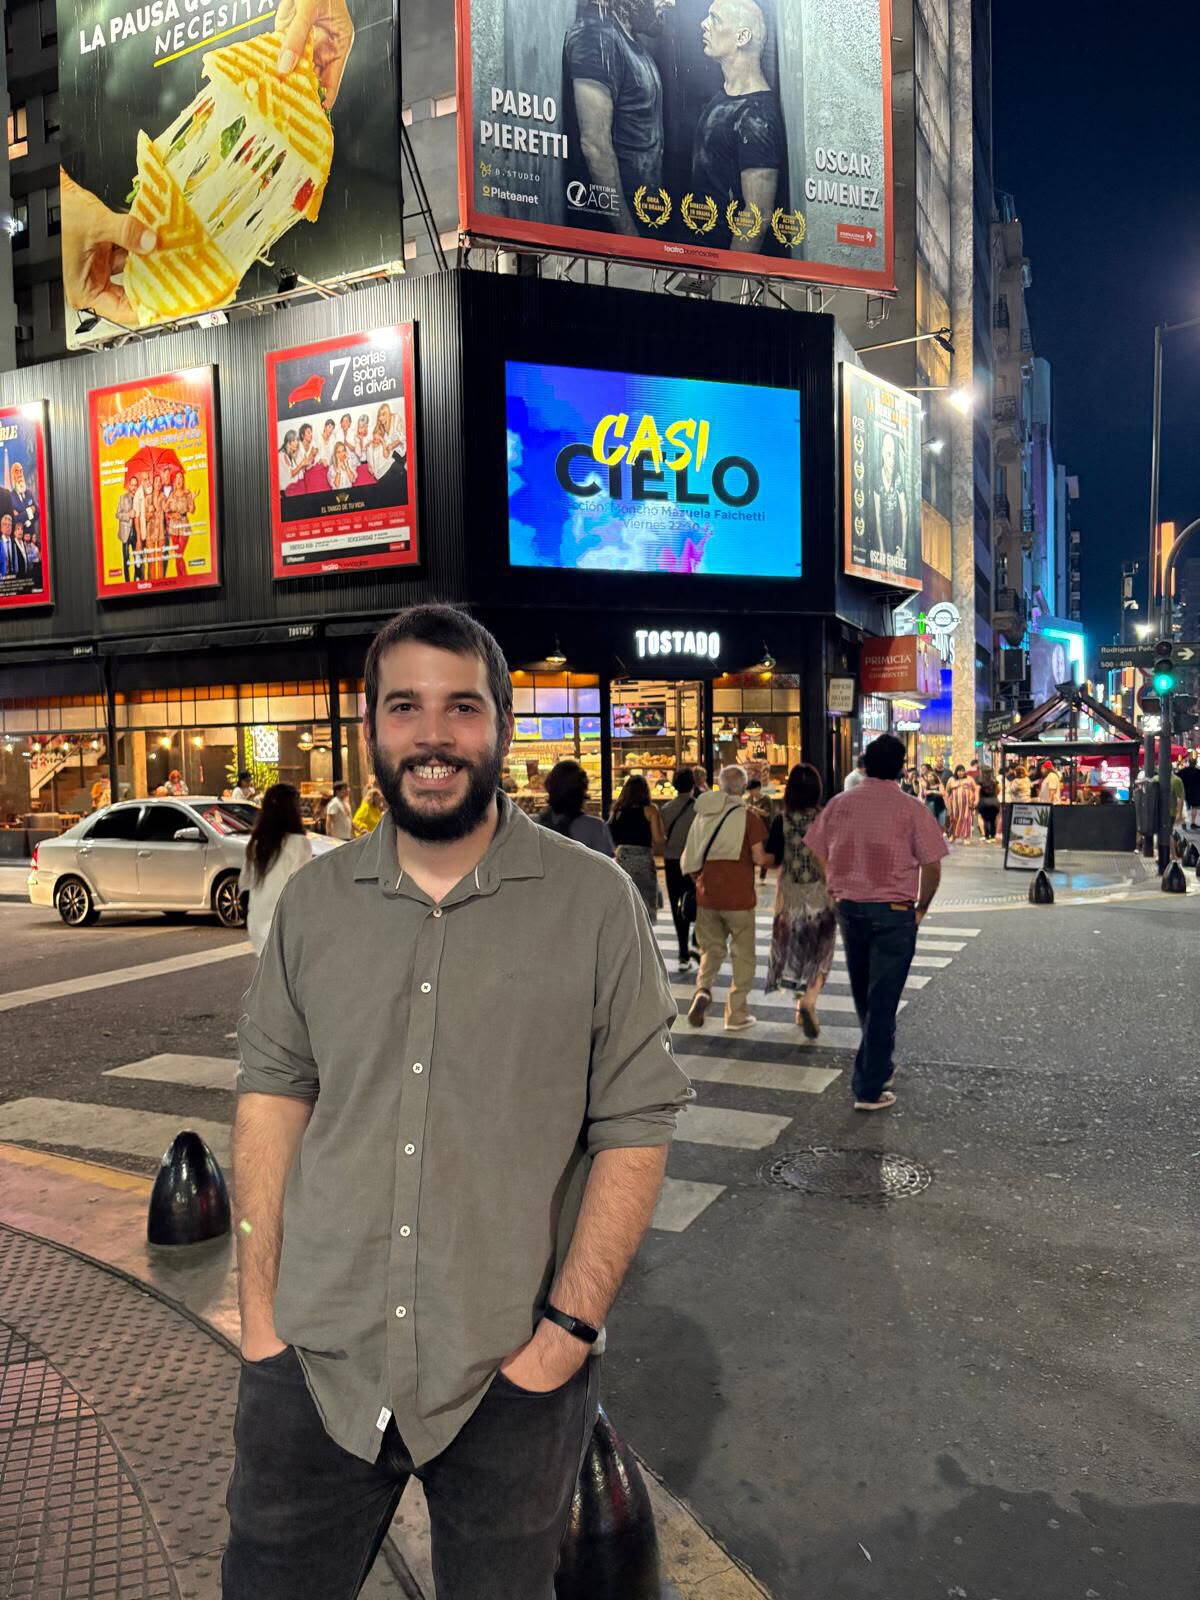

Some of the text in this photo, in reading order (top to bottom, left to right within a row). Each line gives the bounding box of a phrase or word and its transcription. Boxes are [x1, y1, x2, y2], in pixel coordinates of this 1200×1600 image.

[80, 0, 180, 55] LA PAUSA
[491, 86, 557, 123] PABLO
[480, 120, 568, 159] PIERETTI
[815, 146, 871, 178] OSCAR
[490, 187, 539, 205] Plateanet
[587, 191, 620, 211] ACE
[805, 177, 880, 211] GIMENEZ
[329, 350, 386, 401] 7 perlas
[352, 364, 385, 382] sobre
[353, 376, 397, 397] el diván
[592, 413, 710, 474] CASI
[555, 443, 760, 508] CIELO
[623, 518, 666, 530] Viernes
[635, 630, 720, 659] TOSTADO
[864, 654, 912, 667] PRIMICIA
